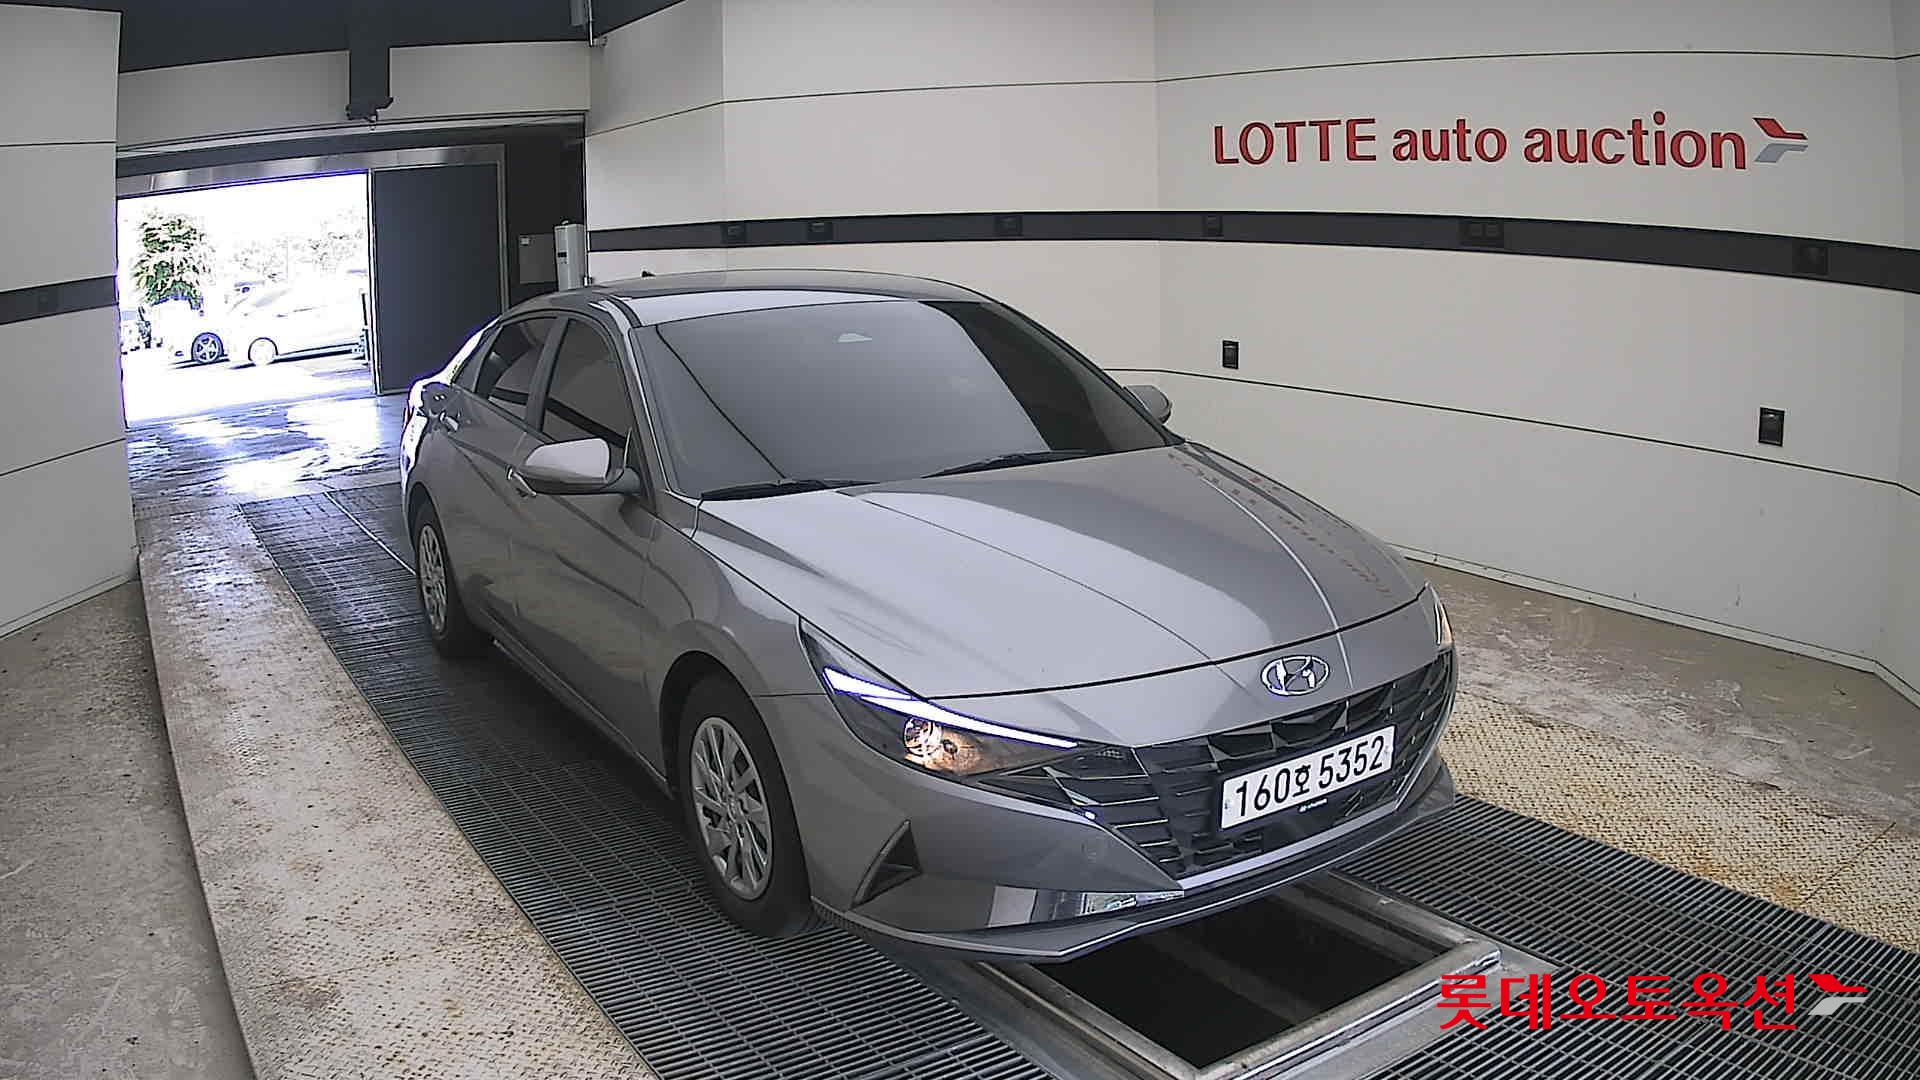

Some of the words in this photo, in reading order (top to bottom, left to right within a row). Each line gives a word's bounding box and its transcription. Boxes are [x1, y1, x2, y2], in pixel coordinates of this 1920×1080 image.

[1214, 118, 1377, 165] LOTTE
[1392, 118, 1507, 163] auto
[1523, 111, 1746, 170] auction
[1318, 735, 1385, 789] 5352
